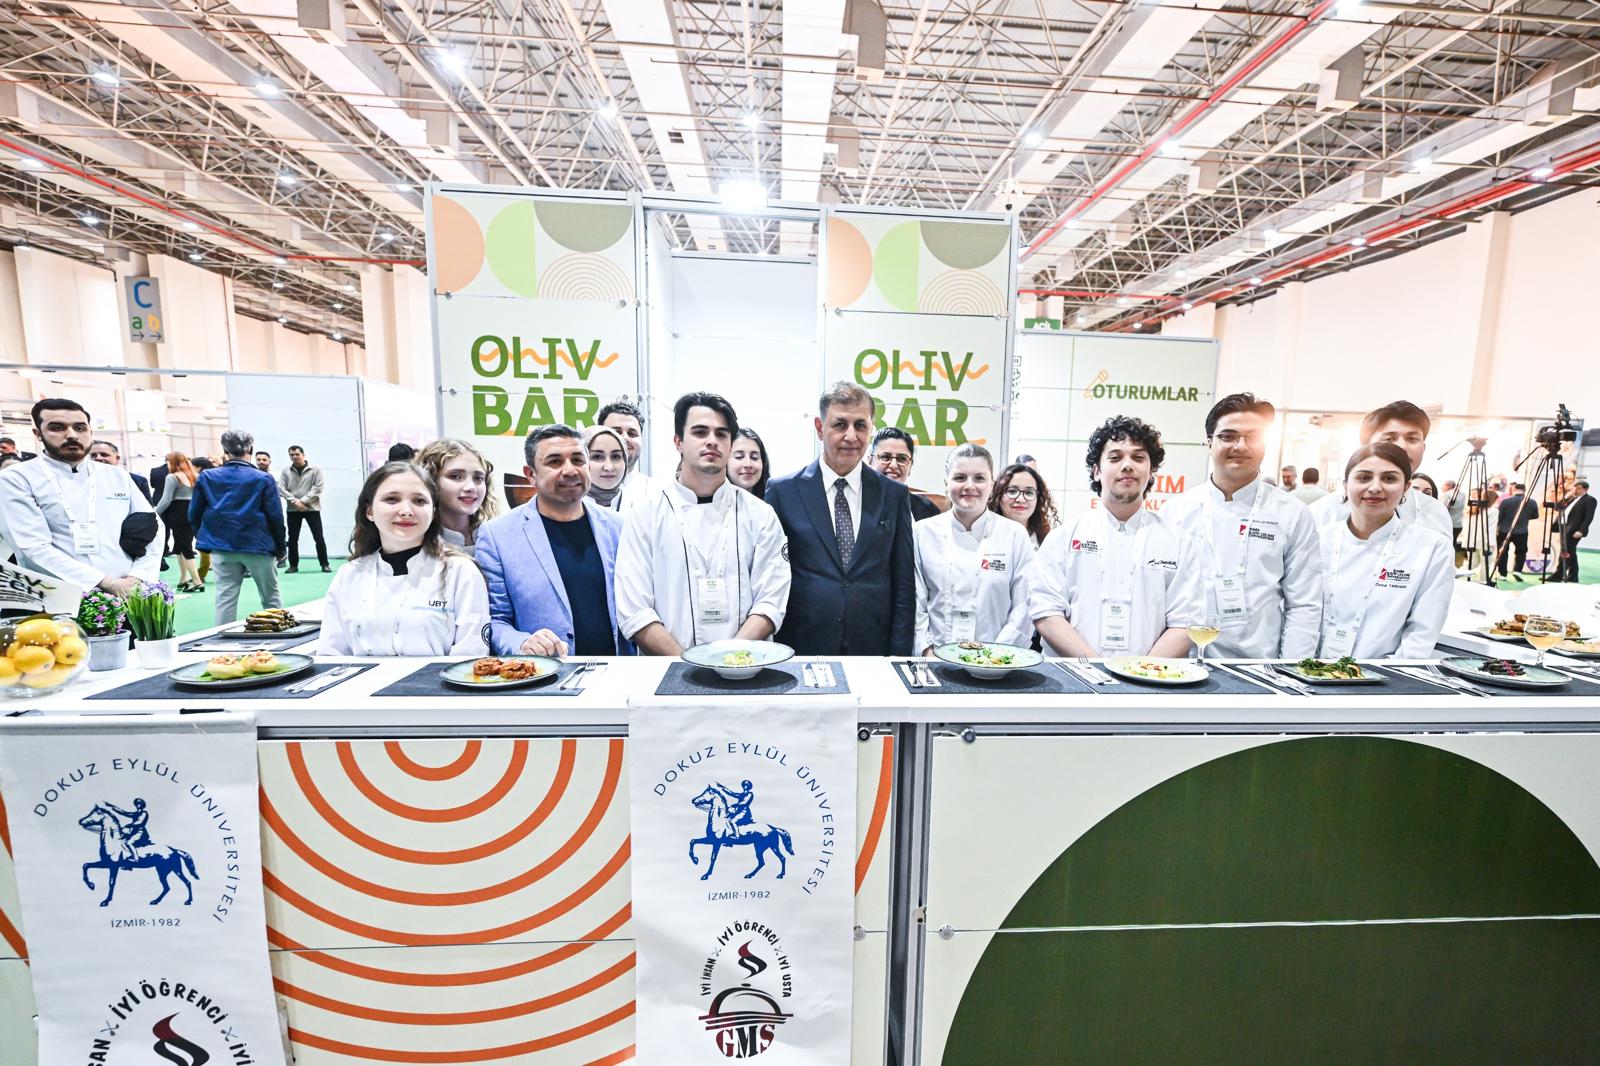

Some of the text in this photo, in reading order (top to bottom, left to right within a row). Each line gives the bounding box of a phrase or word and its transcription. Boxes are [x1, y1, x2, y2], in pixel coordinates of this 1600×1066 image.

[133, 280, 152, 308] C
[132, 316, 143, 329] a
[471, 335, 601, 381] OLIV
[854, 348, 974, 391] OLIV
[1093, 384, 1198, 401] OTURUMLAR
[472, 385, 600, 436] BAR
[428, 600, 448, 608] UBY
[654, 742, 834, 895] DOKUZ EYLÜL ÜNİVERSİTESİ
[34, 759, 241, 924] DOKUZ EYLÜL ÜNİVERSİTESİ
[717, 926, 734, 946] İYİ
[778, 955, 792, 970] İYİ
[108, 988, 141, 1020] İYİ
[139, 977, 229, 1025] ÖĞRENCİ
[782, 974, 792, 998] USTA
[715, 1024, 776, 1058] GMS
